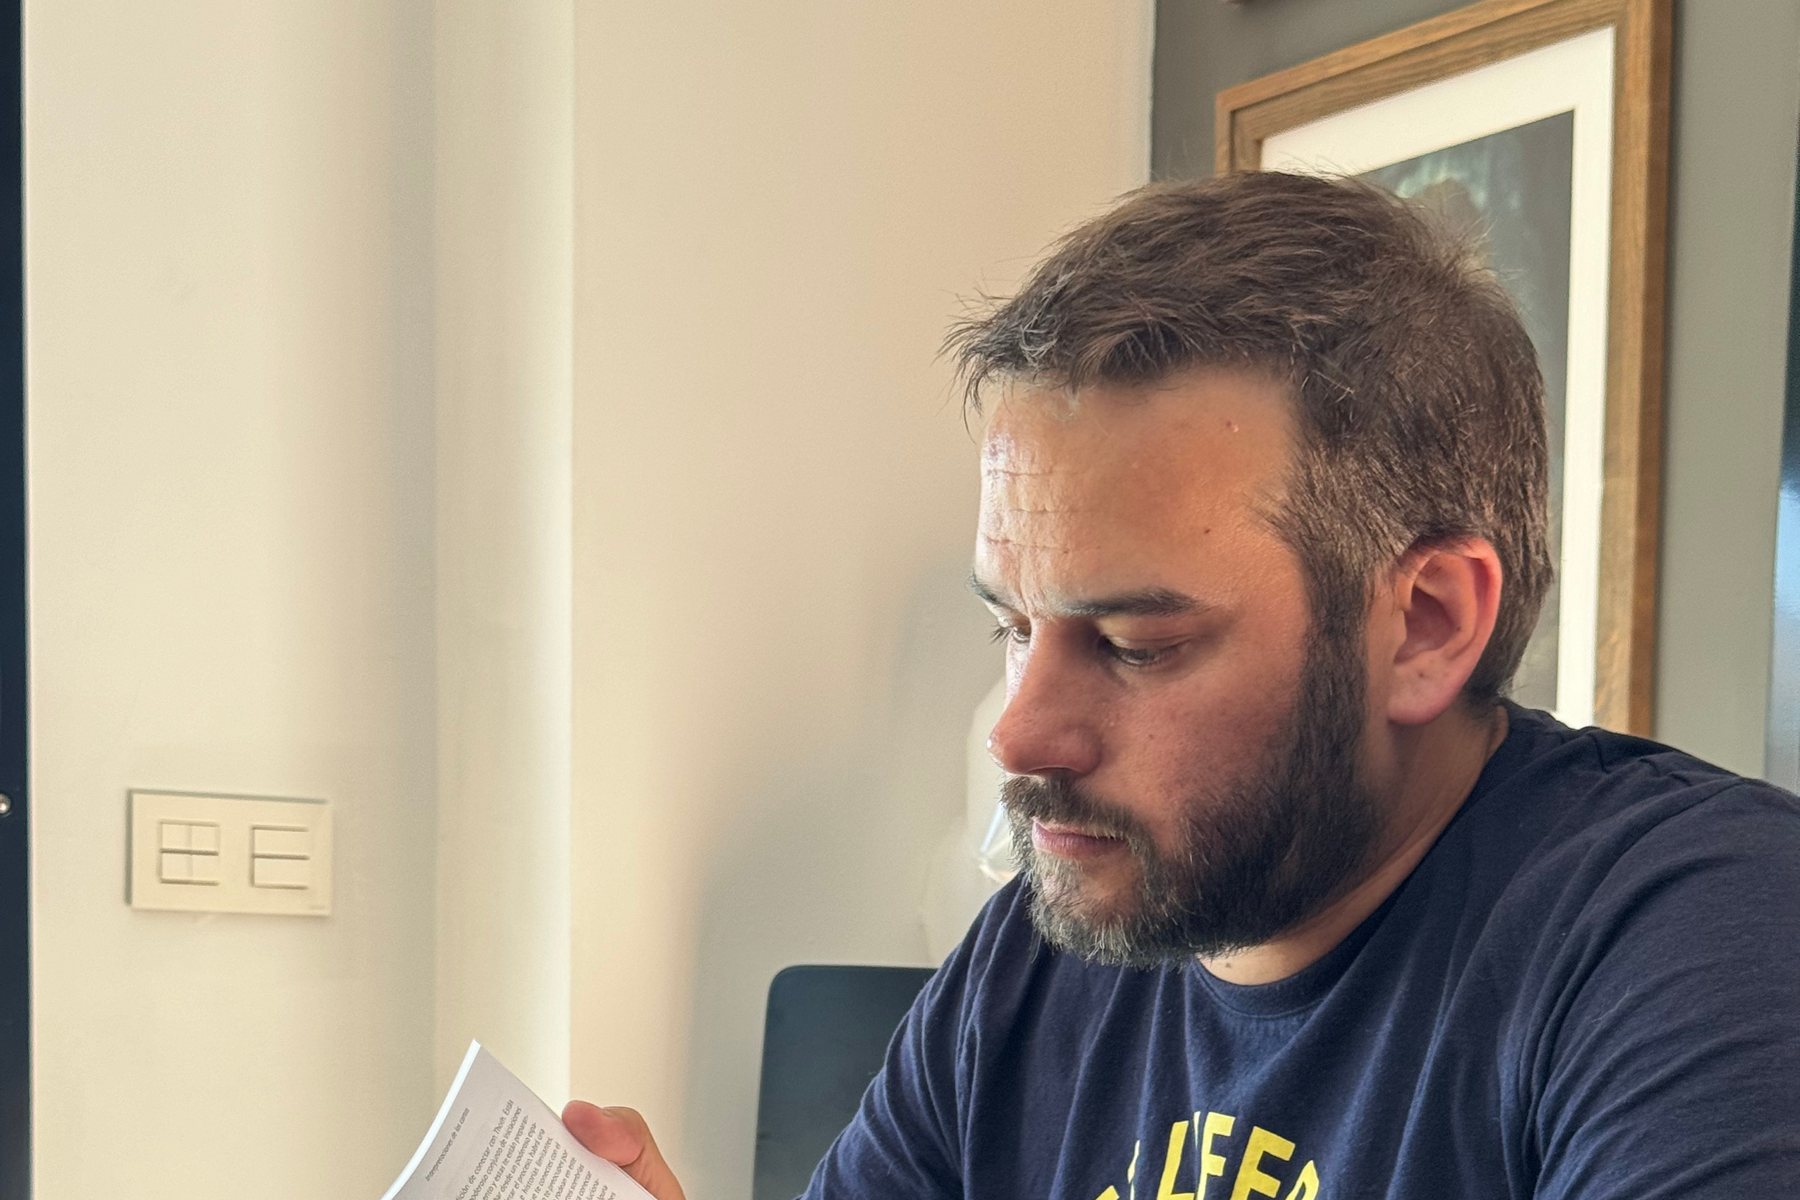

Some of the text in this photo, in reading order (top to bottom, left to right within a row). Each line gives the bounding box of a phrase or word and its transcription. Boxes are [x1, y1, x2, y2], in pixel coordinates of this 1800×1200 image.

[503, 1105, 522, 1140] iniciaciones
[499, 1138, 508, 1149] de
[505, 1141, 517, 1159] están
[528, 1138, 540, 1158] habrá
[537, 1128, 546, 1141] una
[467, 1173, 477, 1185] de
[473, 1146, 491, 1175] conectar
[488, 1134, 498, 1148] con
[485, 1146, 504, 1176] conjunto
[499, 1172, 514, 1193] desde
[514, 1136, 532, 1167] poderoso
[501, 1156, 510, 1166] te
[537, 1159, 554, 1187] conectes
[547, 1160, 565, 1193] preocupes
[561, 1149, 570, 1163] por
[521, 1166, 540, 1195] historias
[533, 1184, 542, 1194] te
[554, 1177, 567, 1200] rodean
[567, 1156, 577, 1171] este
[569, 1163, 585, 1191] sombrías
[577, 1169, 592, 1197] conectar
